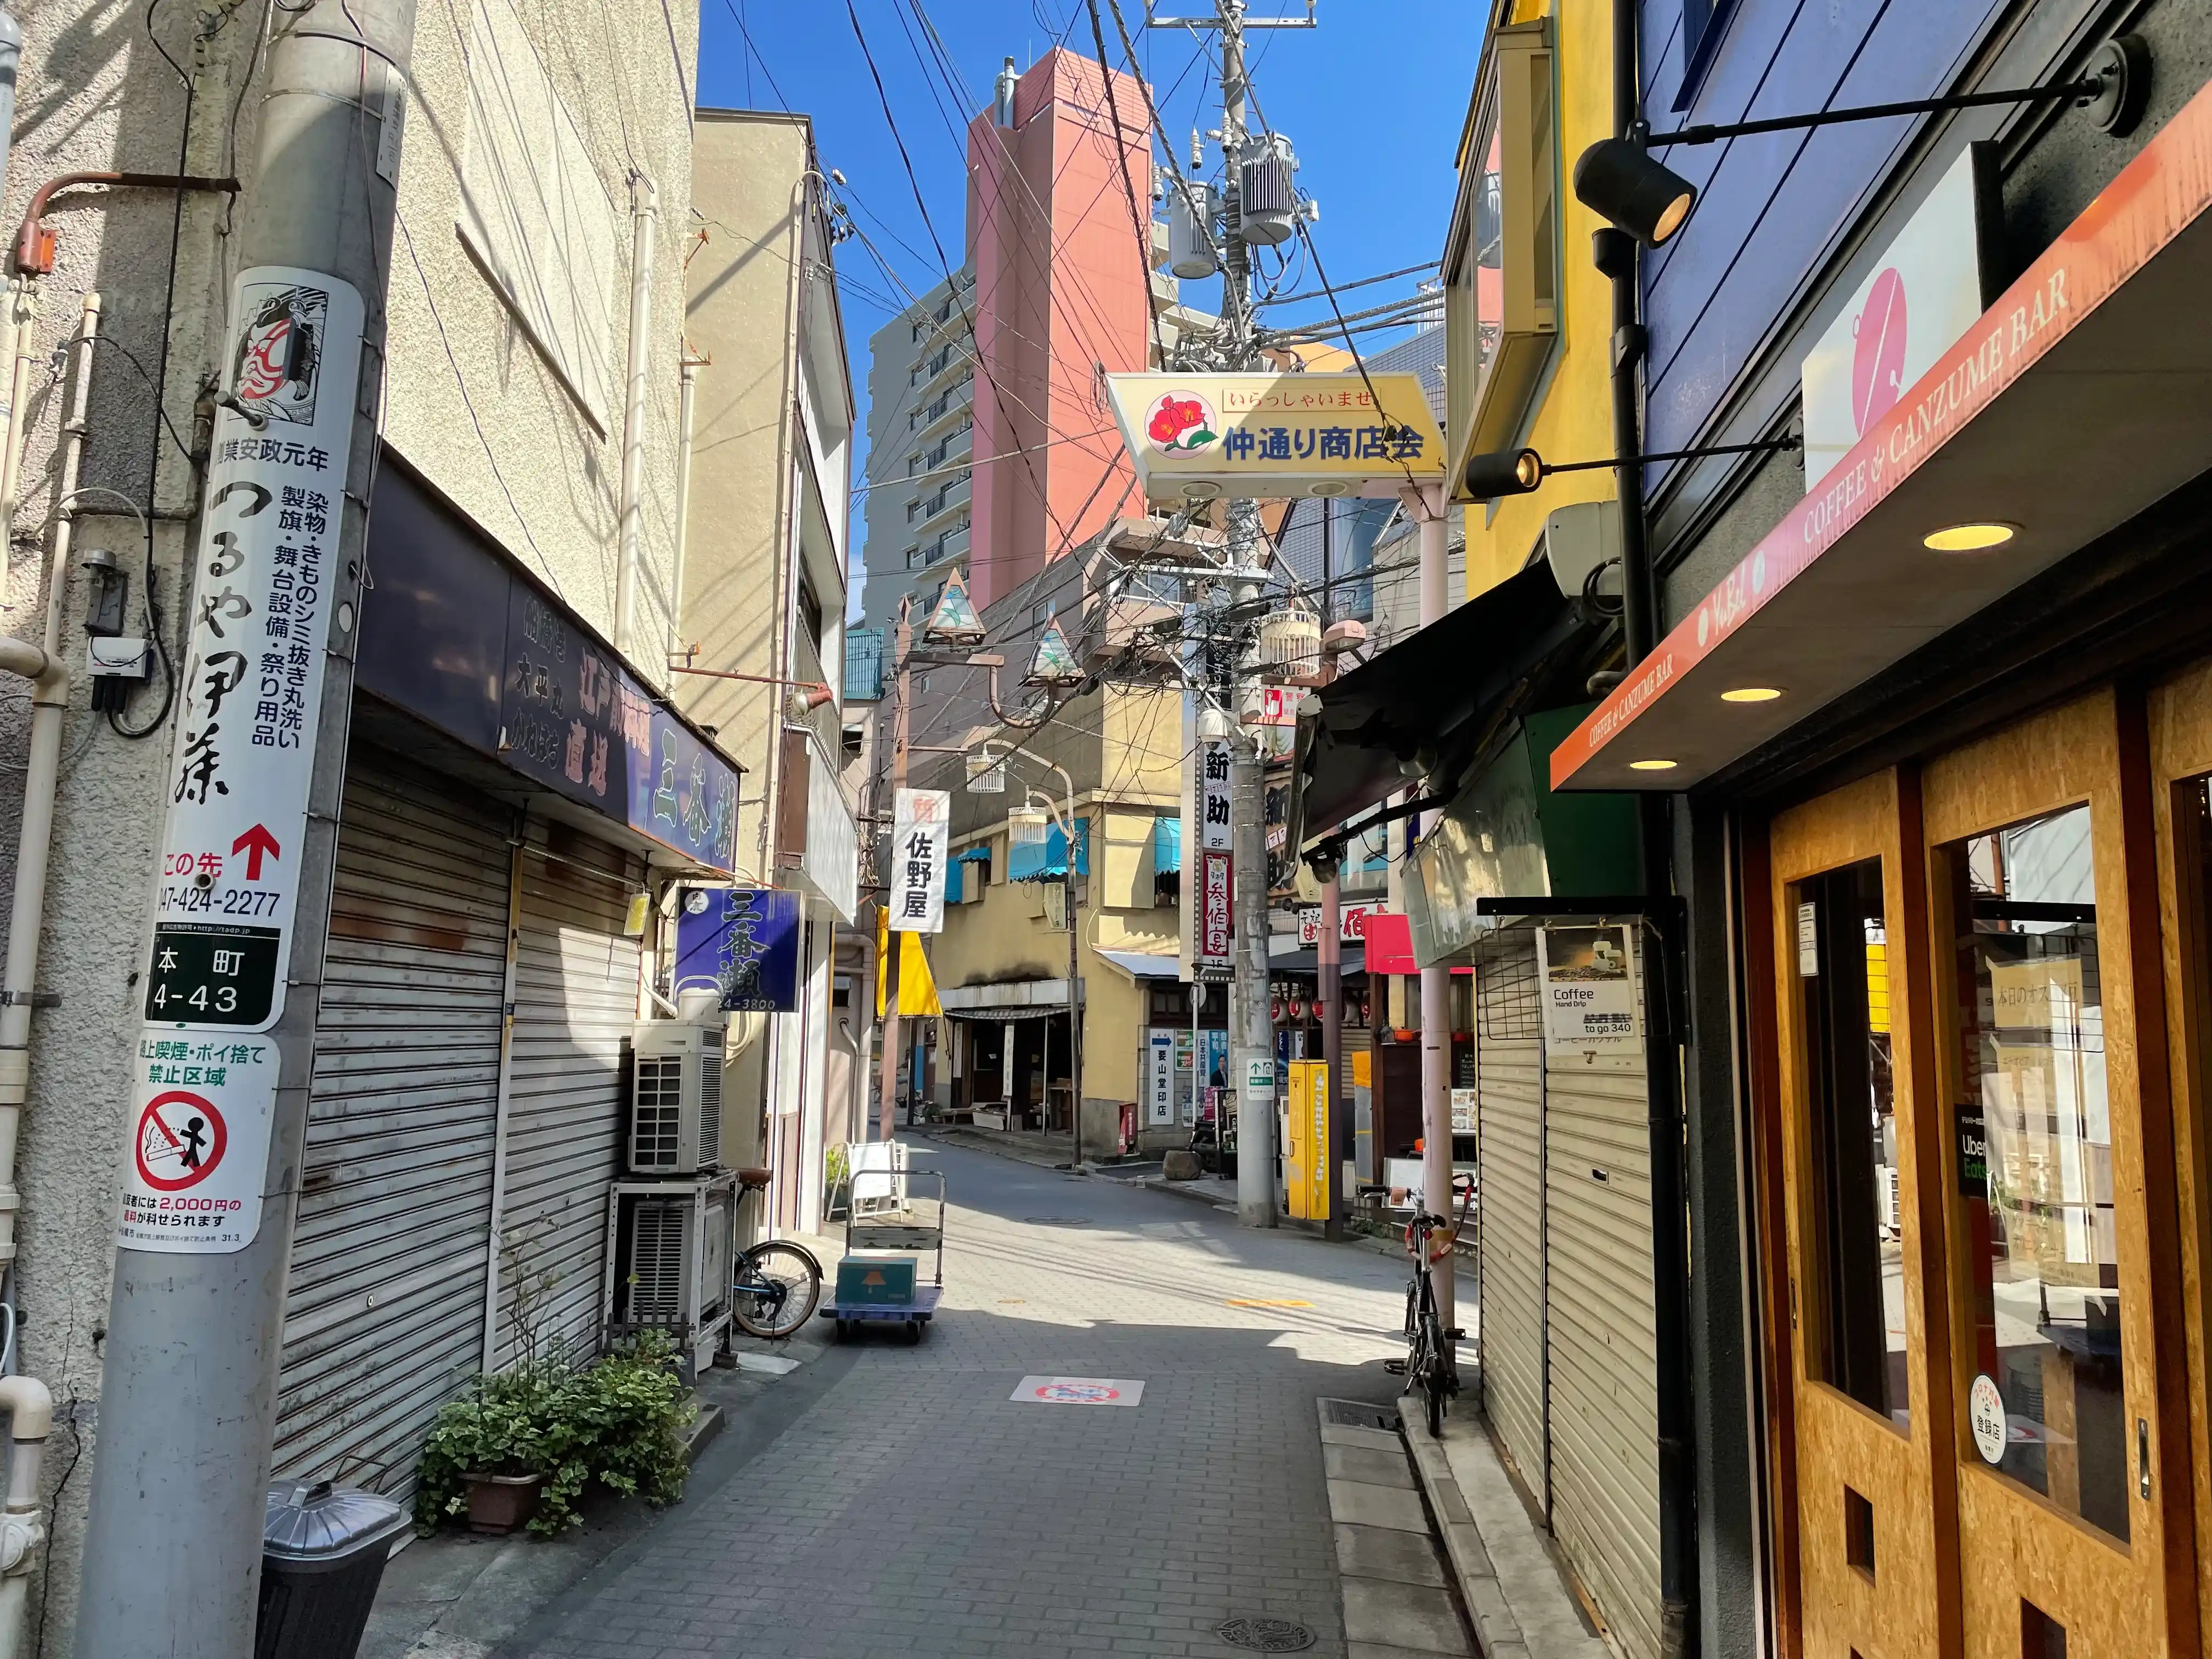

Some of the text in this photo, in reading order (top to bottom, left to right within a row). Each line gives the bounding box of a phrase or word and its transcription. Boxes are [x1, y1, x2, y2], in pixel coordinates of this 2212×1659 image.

[1229, 390, 1372, 408] いらっしゃいませ
[1804, 268, 2069, 544] COFFEE & CANZUME BAR
[1223, 425, 1425, 461] 仲通り商店会
[1589, 653, 1674, 748] COFFEE & CANZUME BAR
[1211, 838, 1224, 847] 2F
[902, 831, 933, 918] 佐野屋
[154, 983, 237, 1013] 4-43
[1554, 989, 1594, 1000] Coffee
[1997, 981, 2078, 1007] 本日のオス豆
[1597, 1026, 1609, 1034] go
[1611, 1023, 1631, 1032] 340
[148, 1063, 227, 1087] 禁止区域
[1157, 1050, 1166, 1116] 要山堂印店
[1962, 1134, 1986, 1156] Uber
